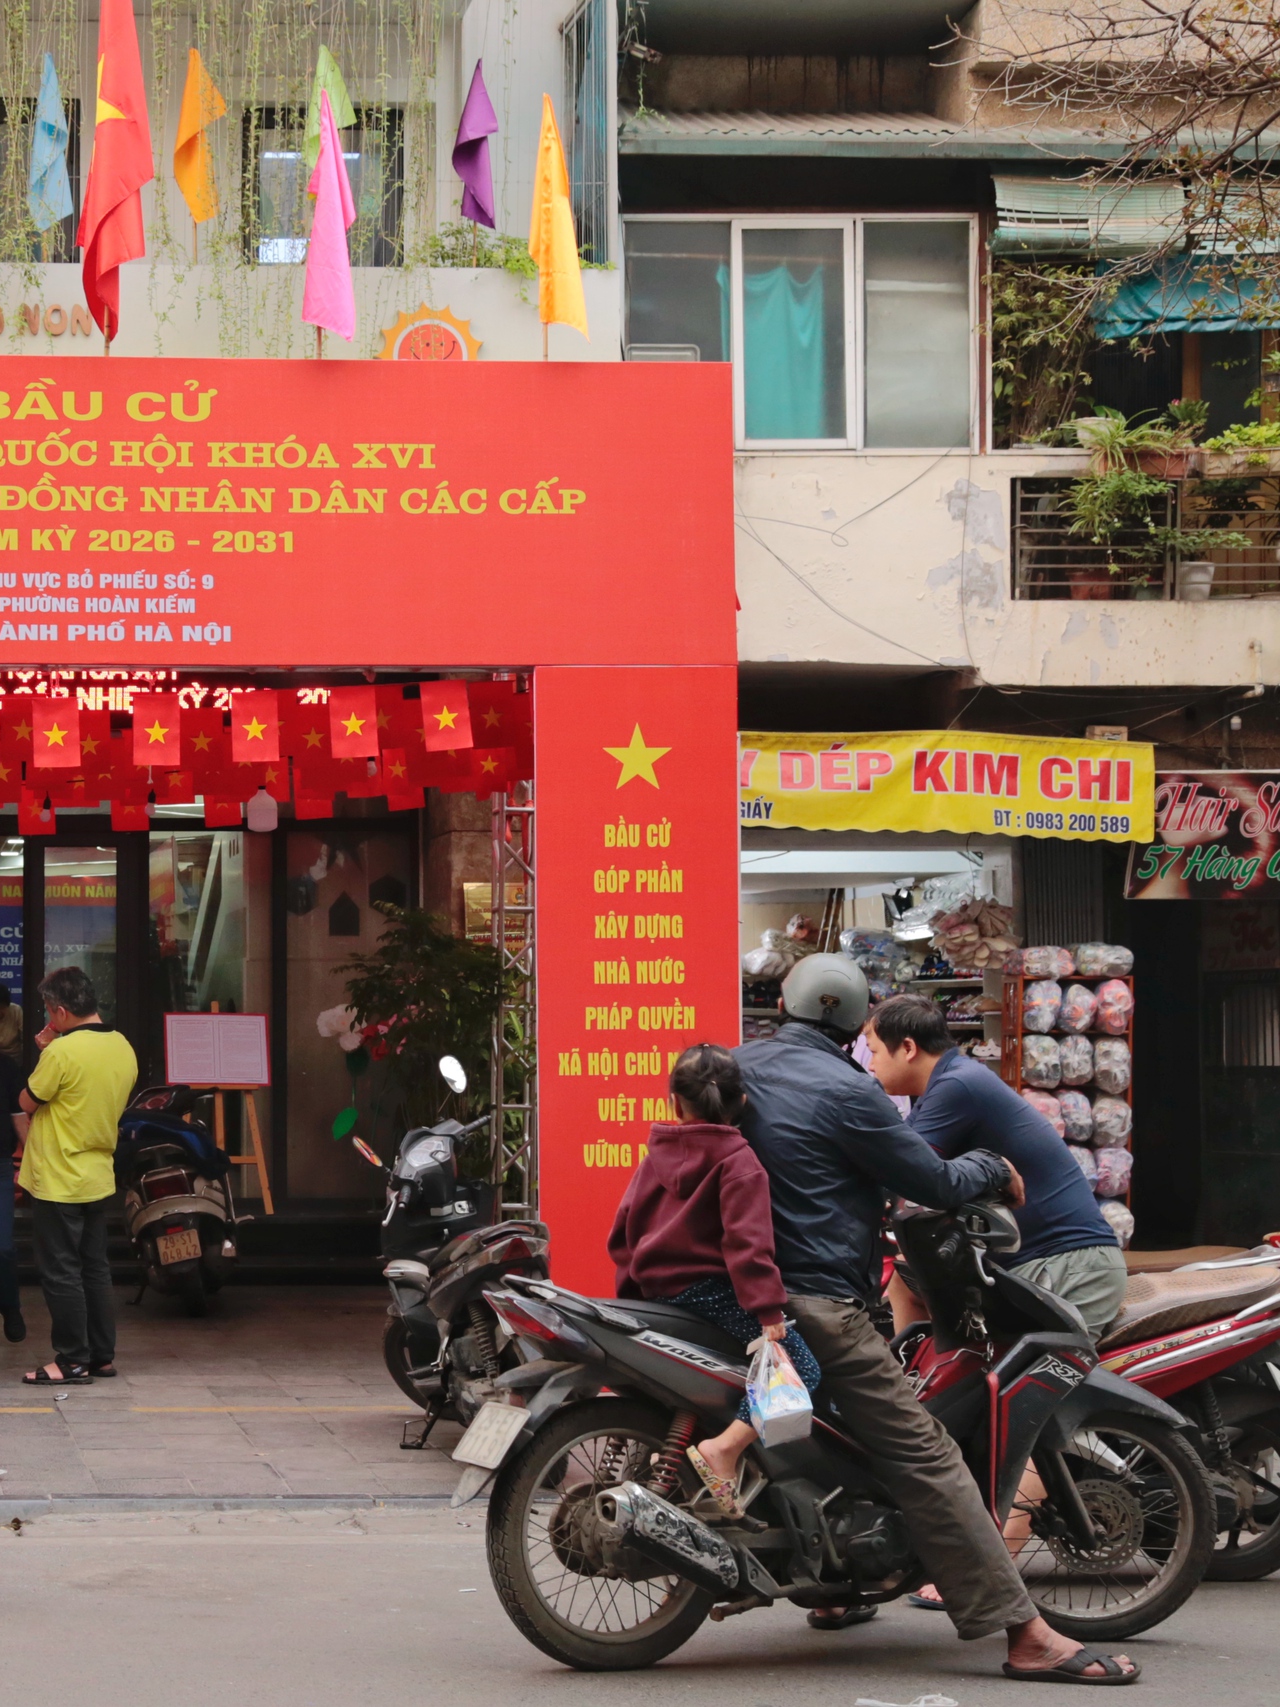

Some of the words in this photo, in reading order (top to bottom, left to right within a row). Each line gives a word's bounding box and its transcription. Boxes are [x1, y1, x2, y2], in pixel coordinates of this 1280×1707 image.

[20, 303, 93, 336] NON
[126, 380, 218, 422] CỬ
[110, 433, 193, 473] HỘI
[207, 435, 339, 468] KHÓA
[352, 444, 435, 468] XVI
[140, 479, 275, 512] NHÂN
[289, 480, 387, 513] DÂN
[400, 481, 487, 514] CÁC
[499, 477, 586, 514] CẤP
[32, 525, 76, 550] KỲ
[88, 530, 174, 552] 2026
[213, 531, 293, 552] 2031
[23, 572, 60, 591] VỰC
[68, 569, 93, 588] BỎ
[100, 570, 157, 589] PHIẾU
[164, 569, 195, 589] SỐ:
[202, 575, 213, 589] 9
[85, 595, 139, 613] HOÀN
[146, 594, 196, 613] KIẾM
[68, 620, 125, 641] PHỐ
[135, 622, 173, 641] HÀ
[183, 622, 231, 645] NỘI
[778, 743, 894, 792] DÉP
[913, 749, 1020, 798] KIM
[1039, 756, 1132, 803] CHI
[994, 810, 1011, 826] ĐT
[1026, 812, 1063, 830] 0983
[1069, 814, 1096, 832] 200
[1100, 816, 1129, 833] 589
[1155, 782, 1239, 833] Hair
[605, 816, 639, 847] BẦU
[647, 817, 671, 847] CỬ
[594, 865, 630, 893] GÓP
[636, 861, 682, 892] PHẦN
[1137, 844, 1185, 880] 57
[1181, 844, 1261, 890] Hàng
[2, 884, 23, 897] NA
[85, 883, 117, 897] NĂM
[595, 911, 628, 938] XÂY
[635, 914, 682, 943] DỰNG
[594, 957, 630, 984] NHÀ
[637, 956, 685, 984] NƯỚC
[586, 1002, 632, 1029] PHÁP
[639, 998, 694, 1031] QUYỀN
